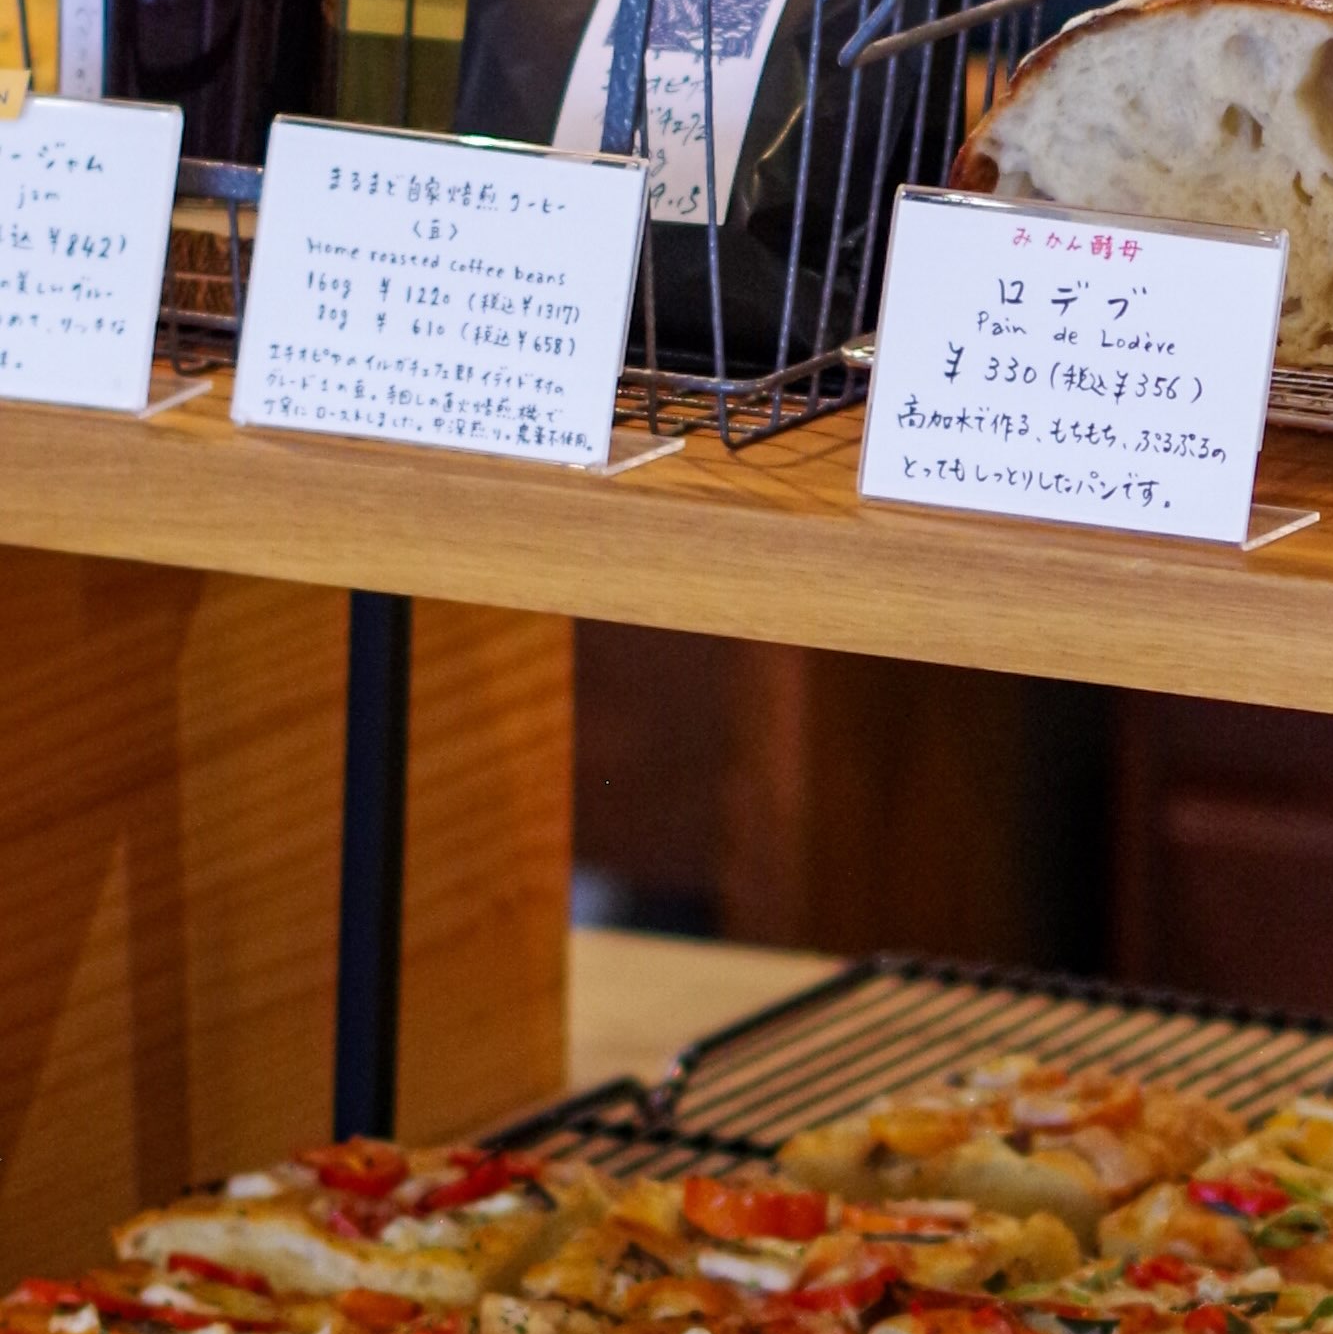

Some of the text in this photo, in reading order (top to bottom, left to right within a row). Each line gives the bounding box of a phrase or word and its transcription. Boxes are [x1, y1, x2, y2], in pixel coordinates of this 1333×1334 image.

[307, 237, 566, 286] Home roasted coffee beans
[1012, 227, 1143, 263] みかん酵母
[307, 271, 353, 298] 160g
[999, 278, 1148, 320] ロデブ
[977, 311, 1176, 356] Pain de Lodève
[903, 455, 1171, 510] とってもしっとりしたパンです。
